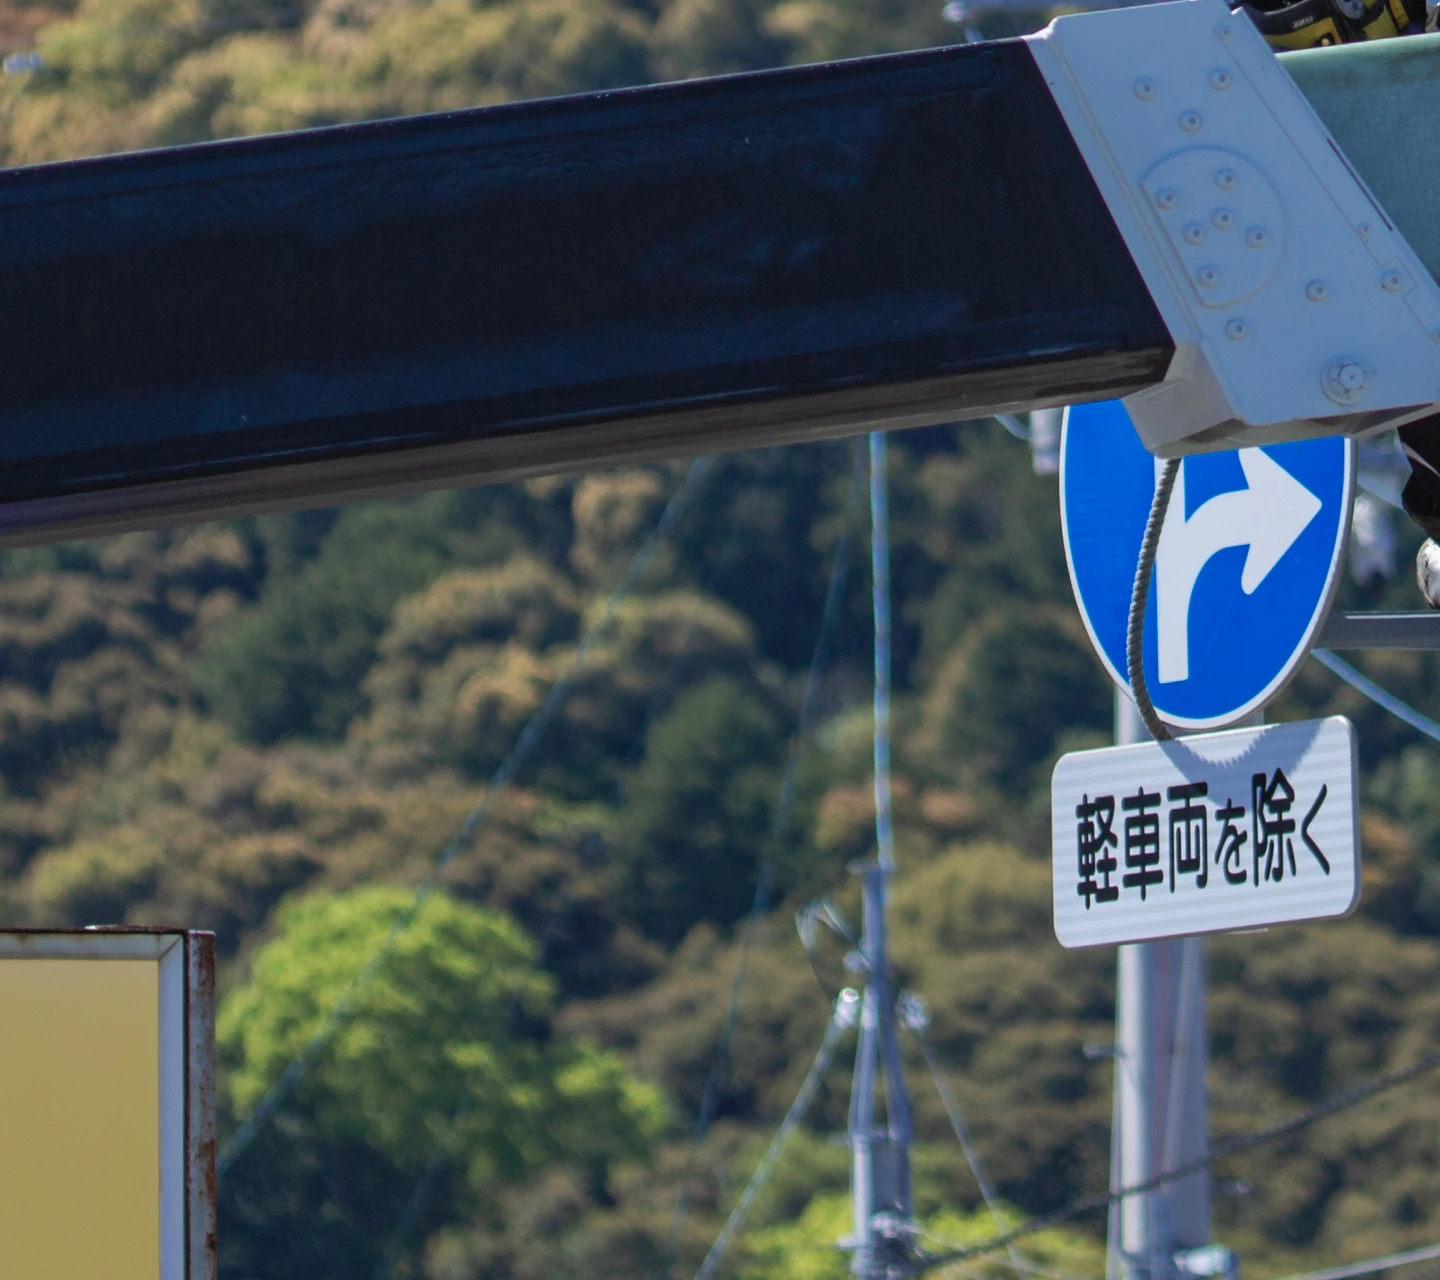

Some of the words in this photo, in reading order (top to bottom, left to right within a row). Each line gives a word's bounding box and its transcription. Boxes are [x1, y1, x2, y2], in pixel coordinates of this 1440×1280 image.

[1075, 766, 1331, 910] 軽車両を除く
